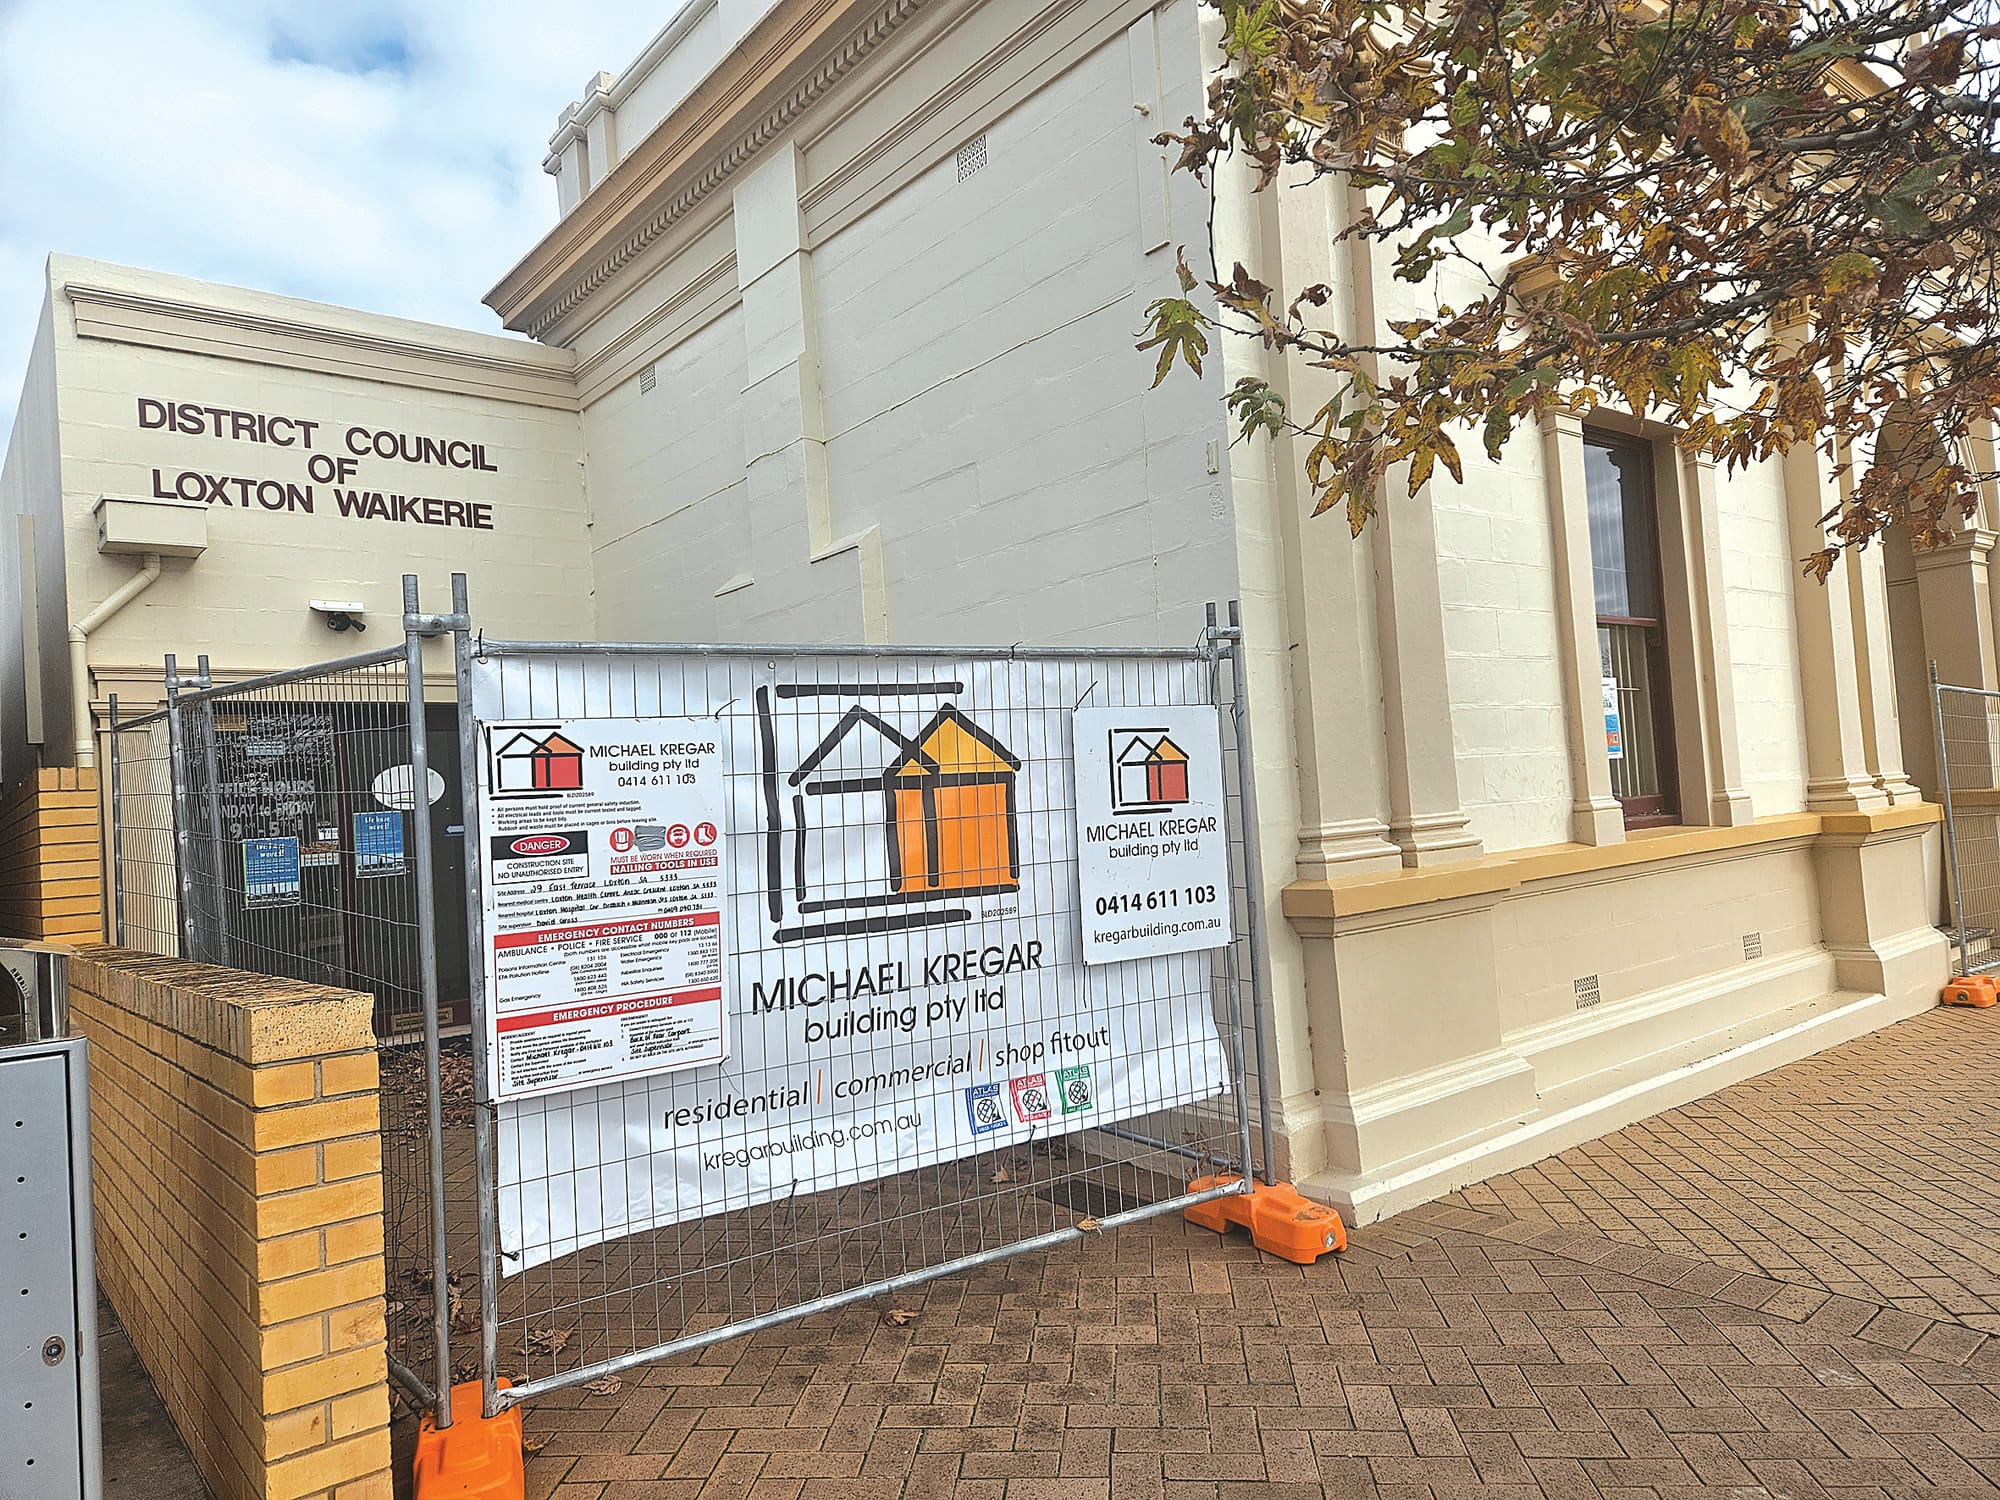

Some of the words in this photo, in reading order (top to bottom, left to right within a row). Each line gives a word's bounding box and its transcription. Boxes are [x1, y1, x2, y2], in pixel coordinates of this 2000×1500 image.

[138, 398, 319, 449] DISTRICT
[346, 426, 498, 472] COUNCIL
[308, 454, 358, 484] OF
[152, 468, 313, 513] LOXTON
[334, 490, 493, 530] WAIKERIE
[590, 744, 656, 757] MICHAEL
[661, 743, 715, 755] KREGAR
[609, 760, 658, 773] building
[663, 759, 682, 771] pty
[686, 758, 699, 769] ltd
[618, 776, 645, 787] 0414
[652, 775, 670, 785] 611
[677, 773, 695, 784] 103
[202, 804, 255, 819] MNDAY
[1086, 822, 1154, 842] MICHAEL
[1159, 816, 1217, 836] KREGAR
[520, 840, 561, 851] DANGER
[1109, 844, 1158, 859] building
[1162, 841, 1181, 856] pty
[1184, 839, 1198, 852] ltd
[507, 859, 557, 869] CONSTRUCTION
[611, 856, 629, 864] MUST
[640, 853, 662, 861] WORN
[685, 849, 717, 858] REQUIRED
[512, 868, 562, 878] UNAUTHORISED
[564, 866, 584, 874] ENTRY
[613, 862, 652, 874] NAILING
[654, 860, 685, 871] TOOLS
[688, 859, 698, 868] IN
[700, 858, 716, 866] USE
[530, 885, 542, 893] 29
[549, 883, 565, 891] East
[570, 882, 595, 890] Terrace
[639, 876, 648, 884] SA
[551, 895, 572, 903] Loxton
[1096, 893, 1142, 915] 0414
[1147, 889, 1178, 910] 611
[1185, 885, 1216, 905] 103
[561, 904, 585, 915] Hospital
[537, 919, 555, 927] David
[538, 928, 599, 943] EMERGENCY
[602, 923, 648, 936] CONTACT
[651, 918, 694, 931] NUMBERS
[1094, 917, 1221, 944] kregarbuilding.com.au
[498, 946, 547, 958] AMBULANCE
[558, 941, 585, 951] POLICE
[596, 938, 610, 947] FIRE
[613, 935, 643, 944] SERVICE
[579, 948, 600, 956] numbers
[752, 968, 909, 1015] MICHAEL
[923, 941, 1043, 987] KREGAR
[511, 994, 541, 1002] Emergency
[554, 1006, 614, 1022] EMERGENCY
[616, 996, 673, 1012] PROCEDURE
[804, 1005, 916, 1043] building
[927, 992, 966, 1025] pty
[974, 986, 1004, 1014] ltd
[553, 1047, 575, 1058] Kregar
[663, 1080, 808, 1130] residential
[834, 1051, 970, 1100] commercial
[995, 1040, 1045, 1069] shop
[1052, 1027, 1110, 1055] fitout
[1063, 1067, 1087, 1077] ATLAS
[1017, 1076, 1043, 1086] ATLAS
[972, 1085, 998, 1095] ATLAS
[703, 1110, 922, 1172] kregarbuilding.com.au
